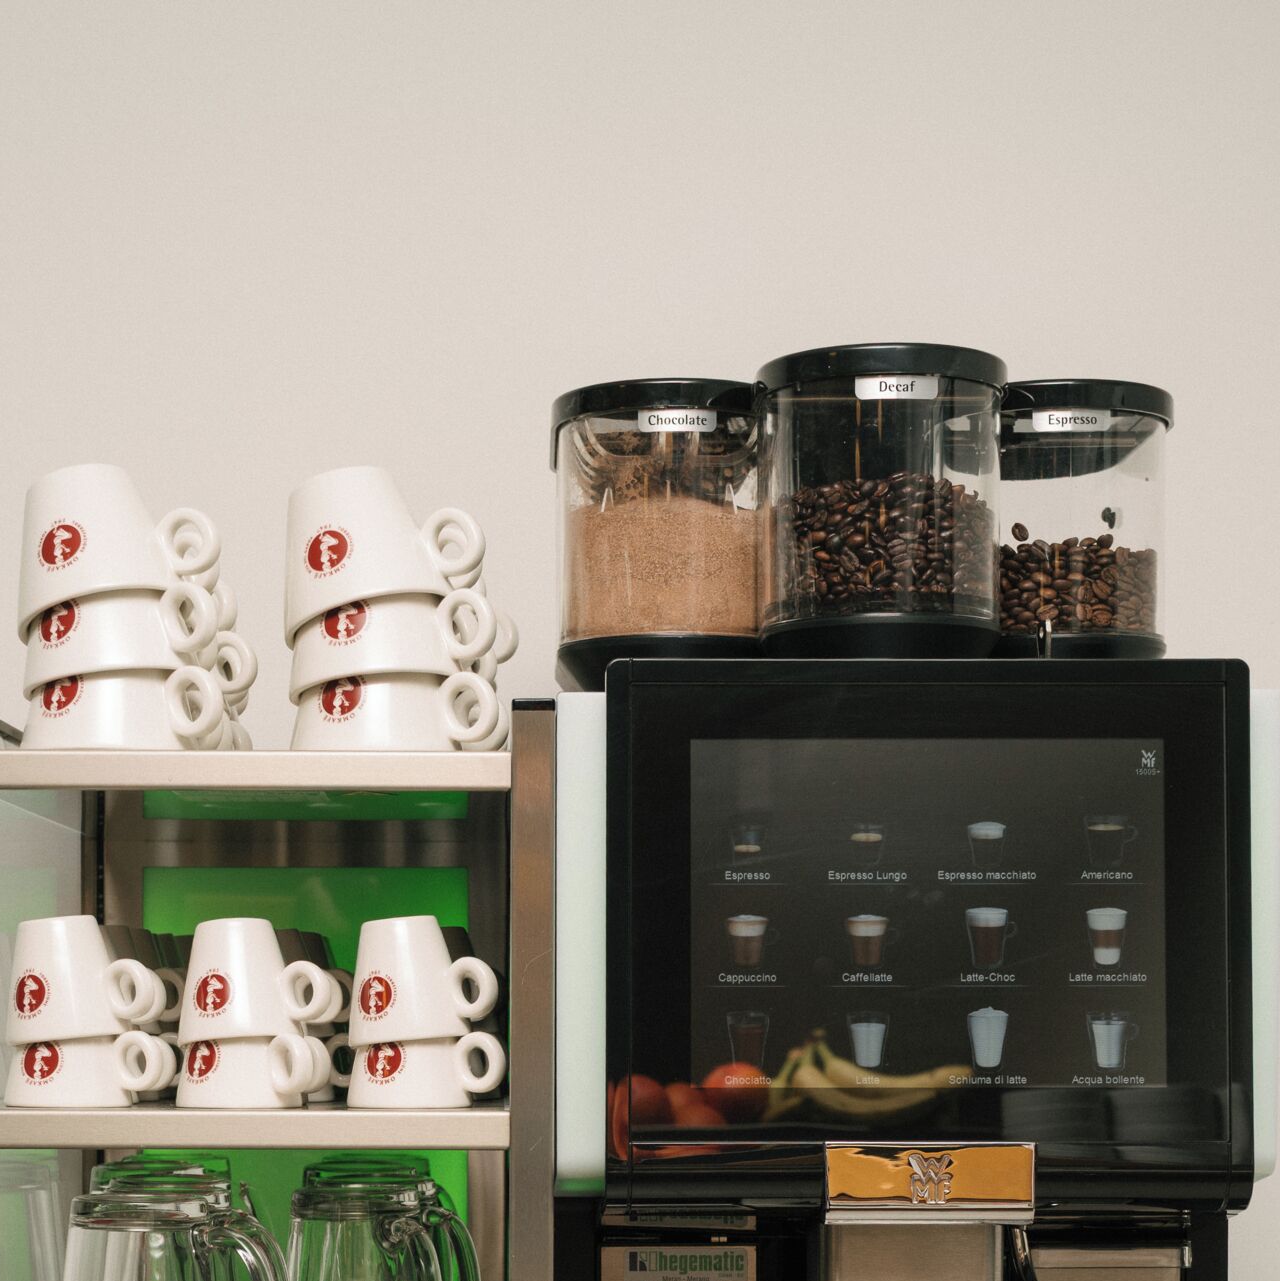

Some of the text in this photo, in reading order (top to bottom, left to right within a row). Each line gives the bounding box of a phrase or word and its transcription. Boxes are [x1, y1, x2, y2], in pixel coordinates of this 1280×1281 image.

[879, 380, 916, 393] Decaf
[648, 414, 708, 426] Chocolate
[1047, 414, 1098, 428] Espresso
[724, 871, 771, 882] Espresso
[827, 871, 908, 882] Espresso Lungo
[937, 870, 1037, 882] Espresso macchiato
[1080, 870, 1133, 881] Americano
[718, 973, 778, 985] Cappuccino
[959, 972, 1016, 983] Latte-Choc
[1068, 973, 1148, 983] Latte macchiato
[855, 1076, 880, 1085] Latte
[948, 1075, 1028, 1085] Schiuma di latte
[1071, 1075, 1145, 1087] Acqua bollente
[908, 1153, 954, 1204] WMF
[658, 1251, 745, 1274] hegematic
